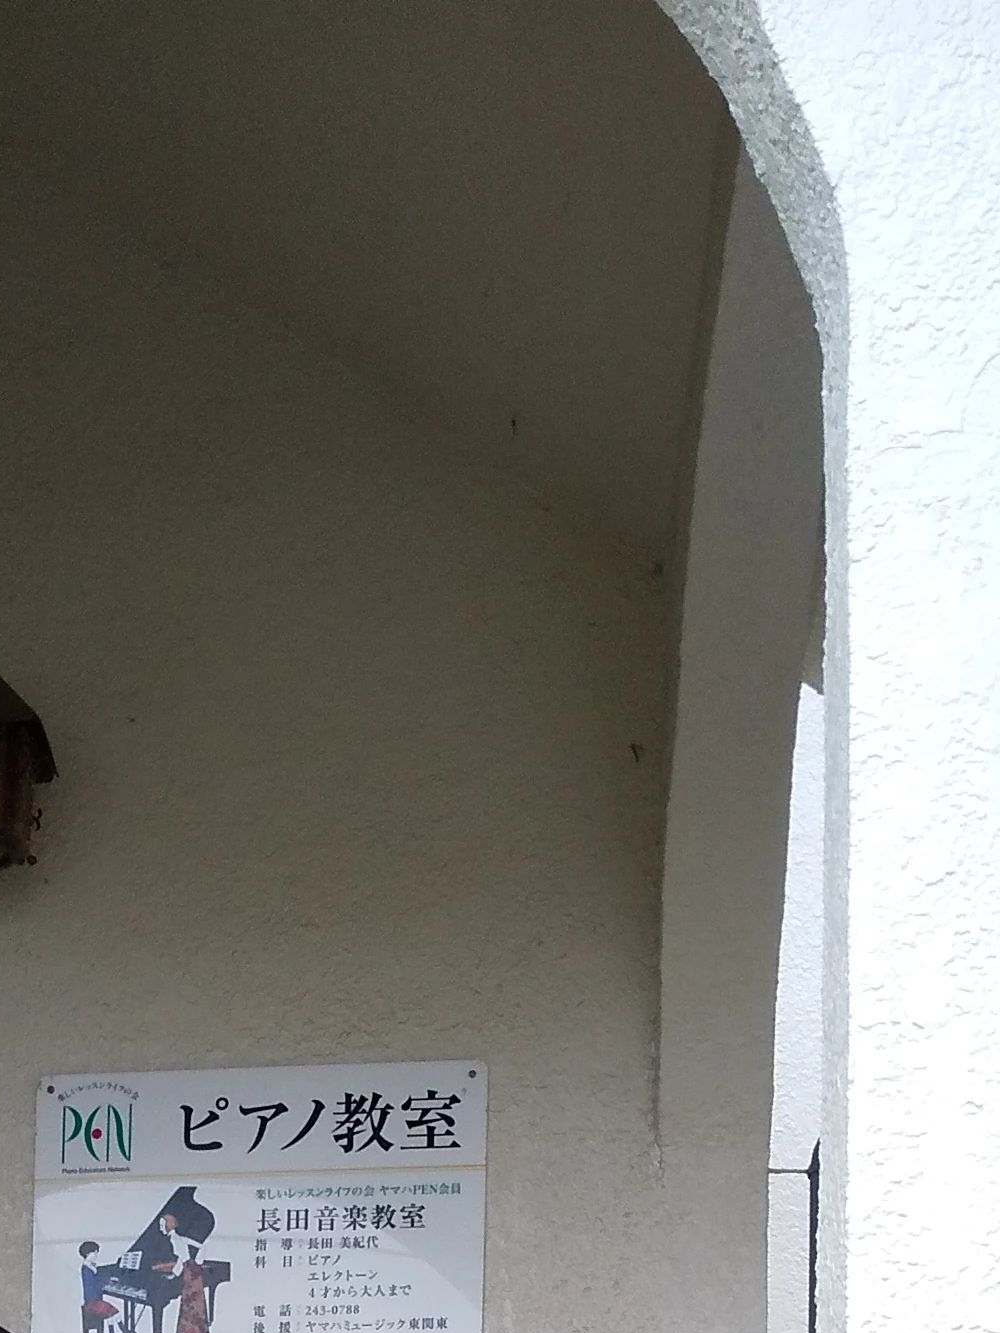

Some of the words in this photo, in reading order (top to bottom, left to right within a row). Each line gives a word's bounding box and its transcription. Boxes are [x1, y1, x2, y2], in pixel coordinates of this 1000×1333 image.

[61, 1103, 133, 1165] PEN
[179, 1088, 463, 1155] ピアノ教室
[256, 1203, 427, 1233] 長田音楽教室
[307, 1269, 378, 1283] エレクトーン
